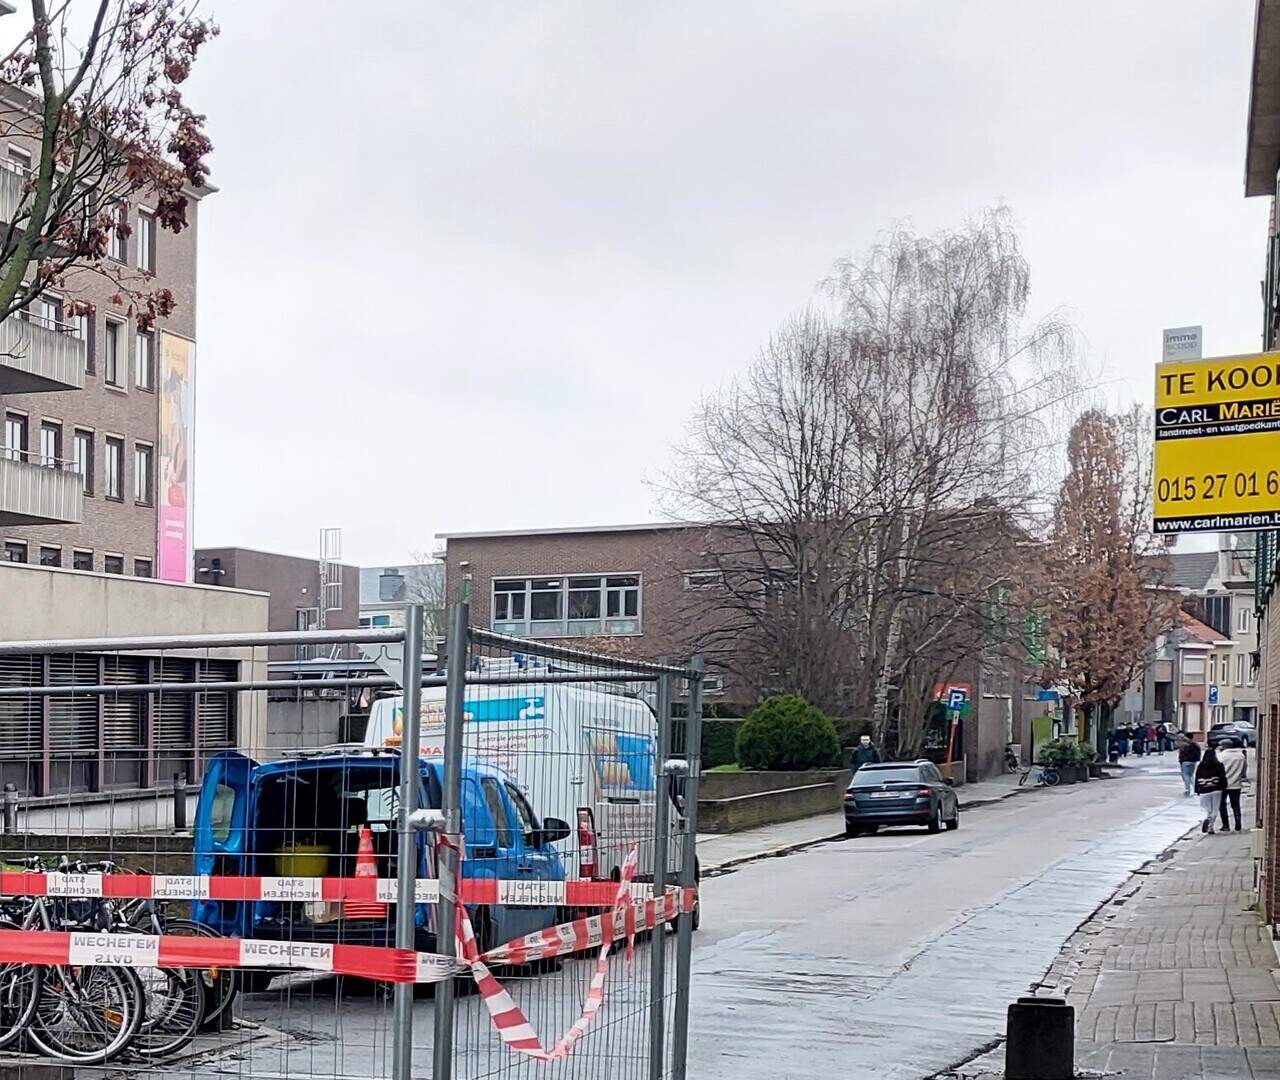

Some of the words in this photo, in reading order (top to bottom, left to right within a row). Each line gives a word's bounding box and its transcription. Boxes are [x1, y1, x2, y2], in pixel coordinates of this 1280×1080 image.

[1160, 372, 1196, 396] TE
[1160, 408, 1213, 425] CARL
[1159, 428, 1205, 438] landmeet-
[1206, 426, 1218, 434] en
[1158, 476, 1196, 502] 015
[1202, 474, 1228, 499] 27
[1234, 471, 1260, 498] 01
[1266, 470, 1280, 495] 6
[950, 692, 964, 708] P
